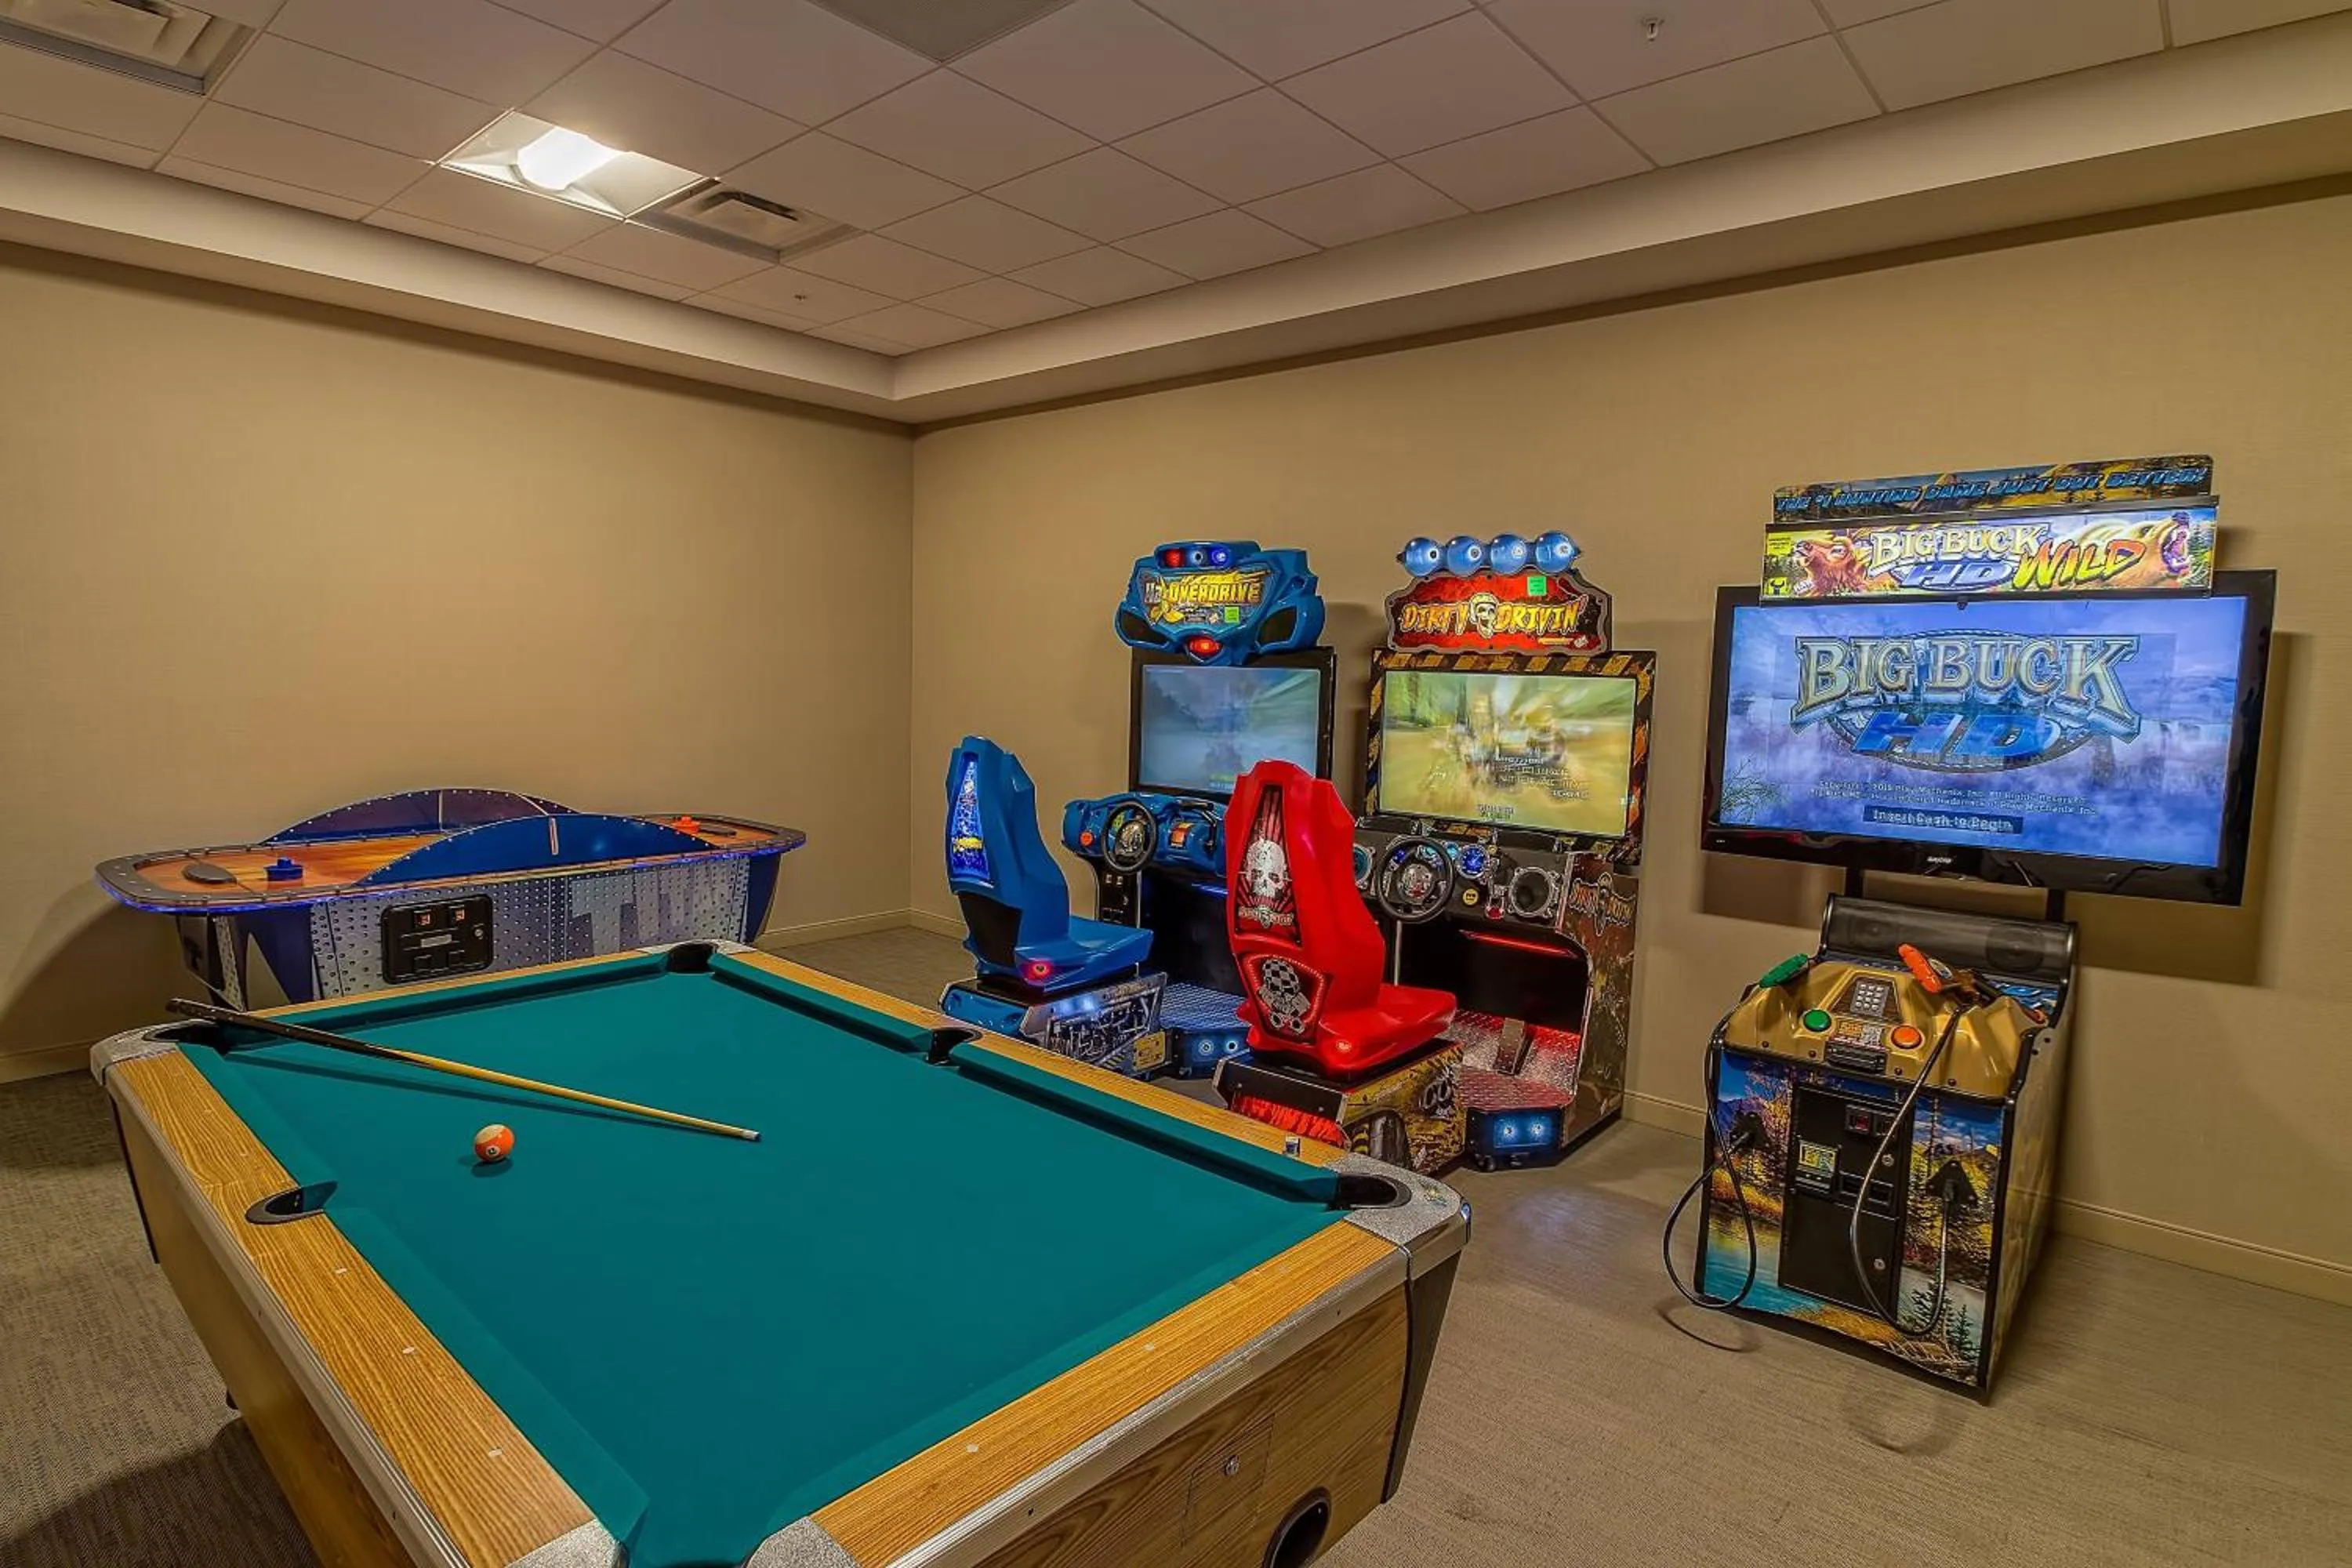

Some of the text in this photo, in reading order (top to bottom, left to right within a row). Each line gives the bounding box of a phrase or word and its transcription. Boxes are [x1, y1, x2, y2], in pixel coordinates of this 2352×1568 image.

[1990, 478, 2052, 495] JUST
[1866, 522, 2050, 579] BIG BUCK
[1898, 538, 2148, 590] HD WILD
[1167, 581, 1262, 604] OVERDRIVE
[1400, 602, 1468, 636] DIRTY
[1791, 635, 2140, 724] BIG BUCK
[1853, 710, 2063, 757] HD
[1970, 817, 2014, 833] Begin
